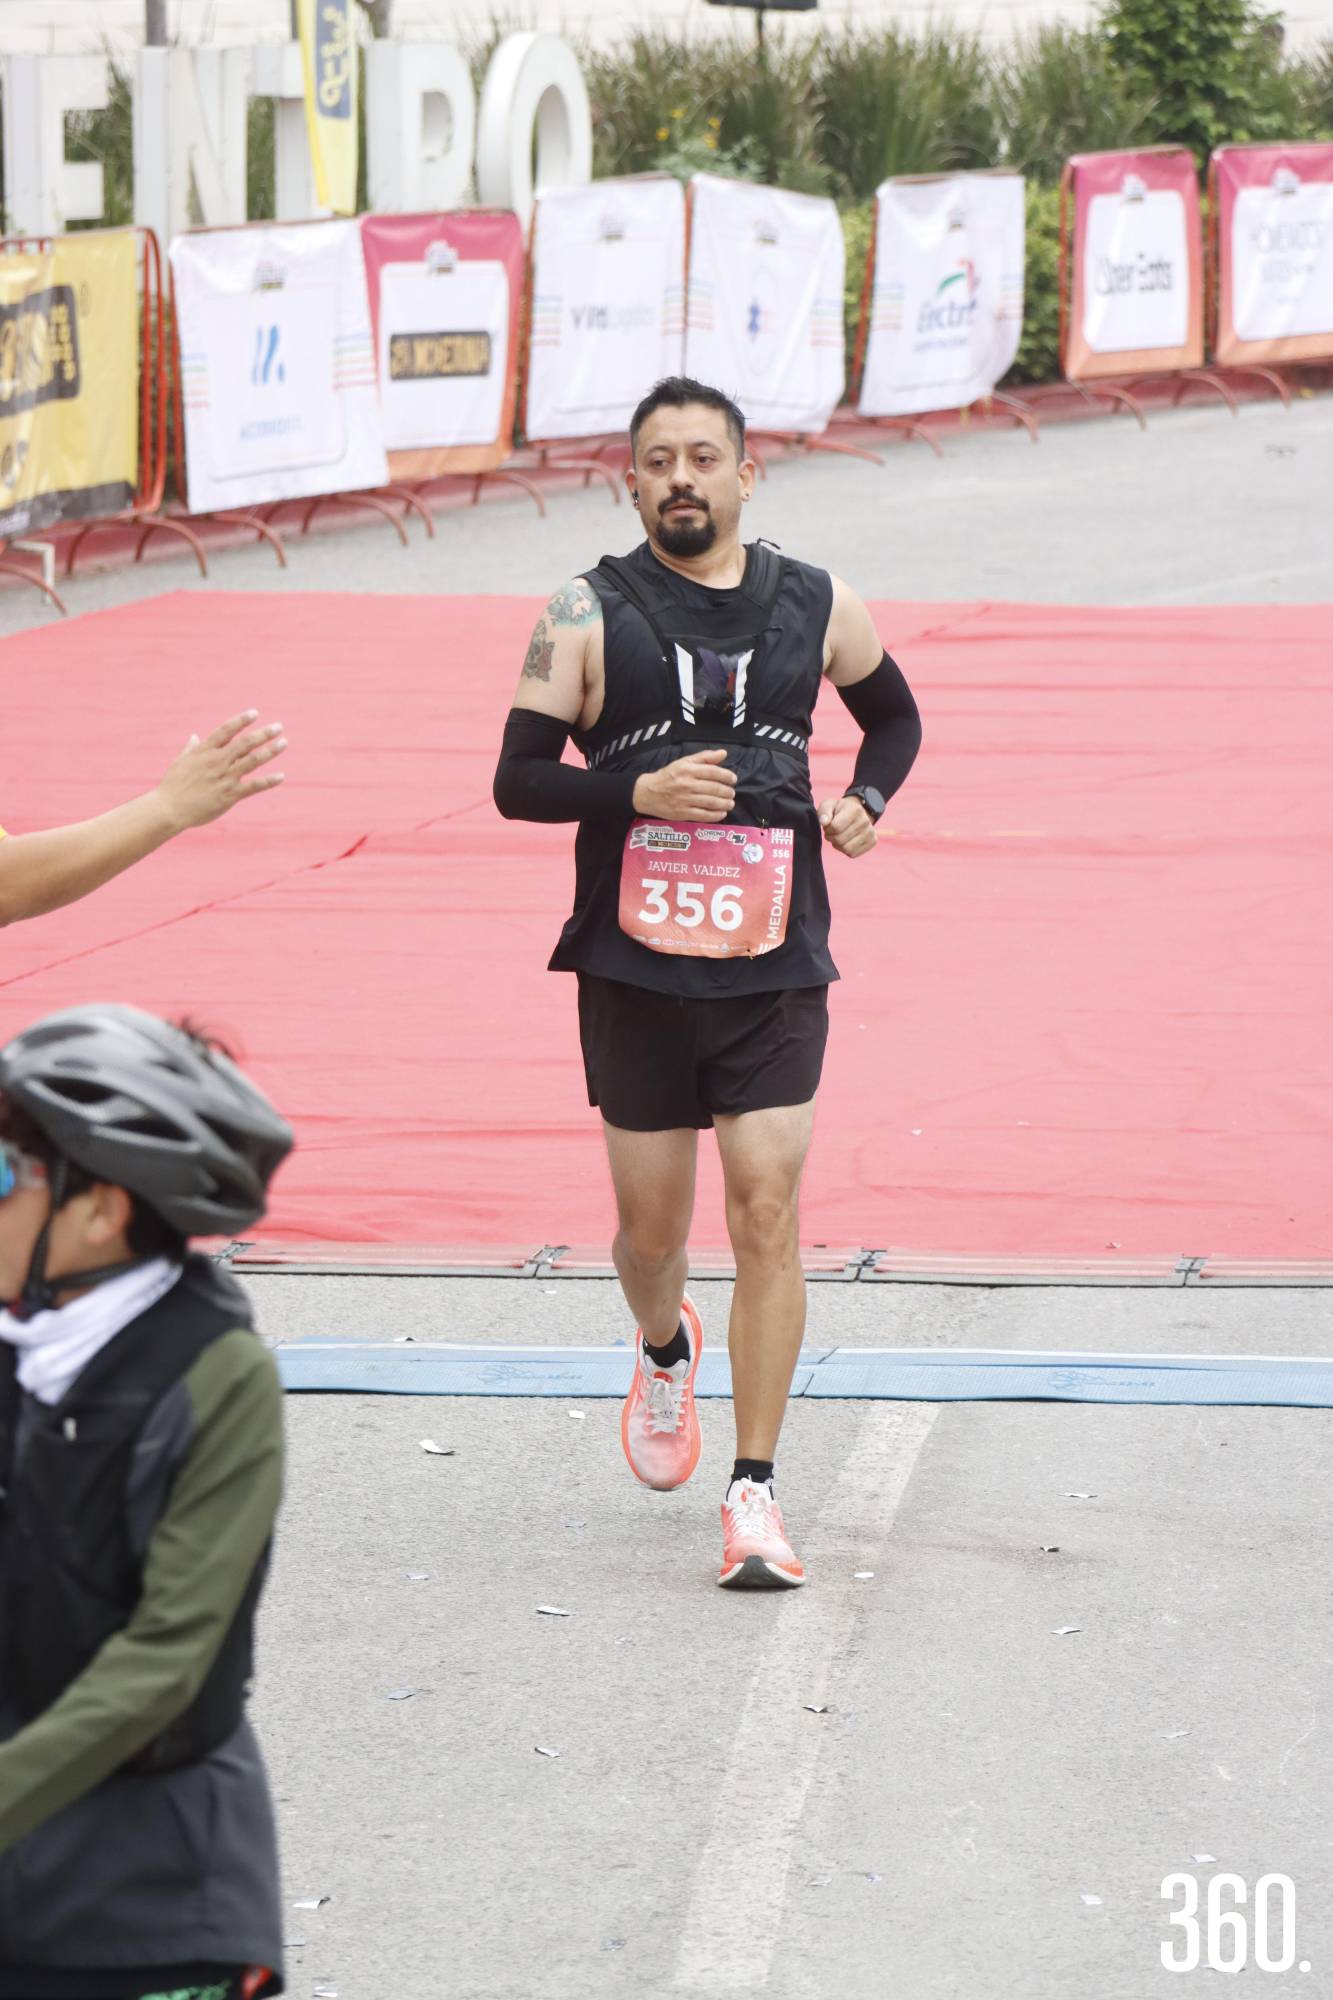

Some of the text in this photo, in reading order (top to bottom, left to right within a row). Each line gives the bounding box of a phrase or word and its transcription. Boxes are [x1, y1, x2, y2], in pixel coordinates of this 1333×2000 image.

[647, 831, 690, 842] SALTILLO
[772, 849, 790, 858] 356
[648, 861, 740, 878] JAVIER VALDEZ
[638, 878, 744, 931] 356
[767, 865, 787, 939] MEDALLA
